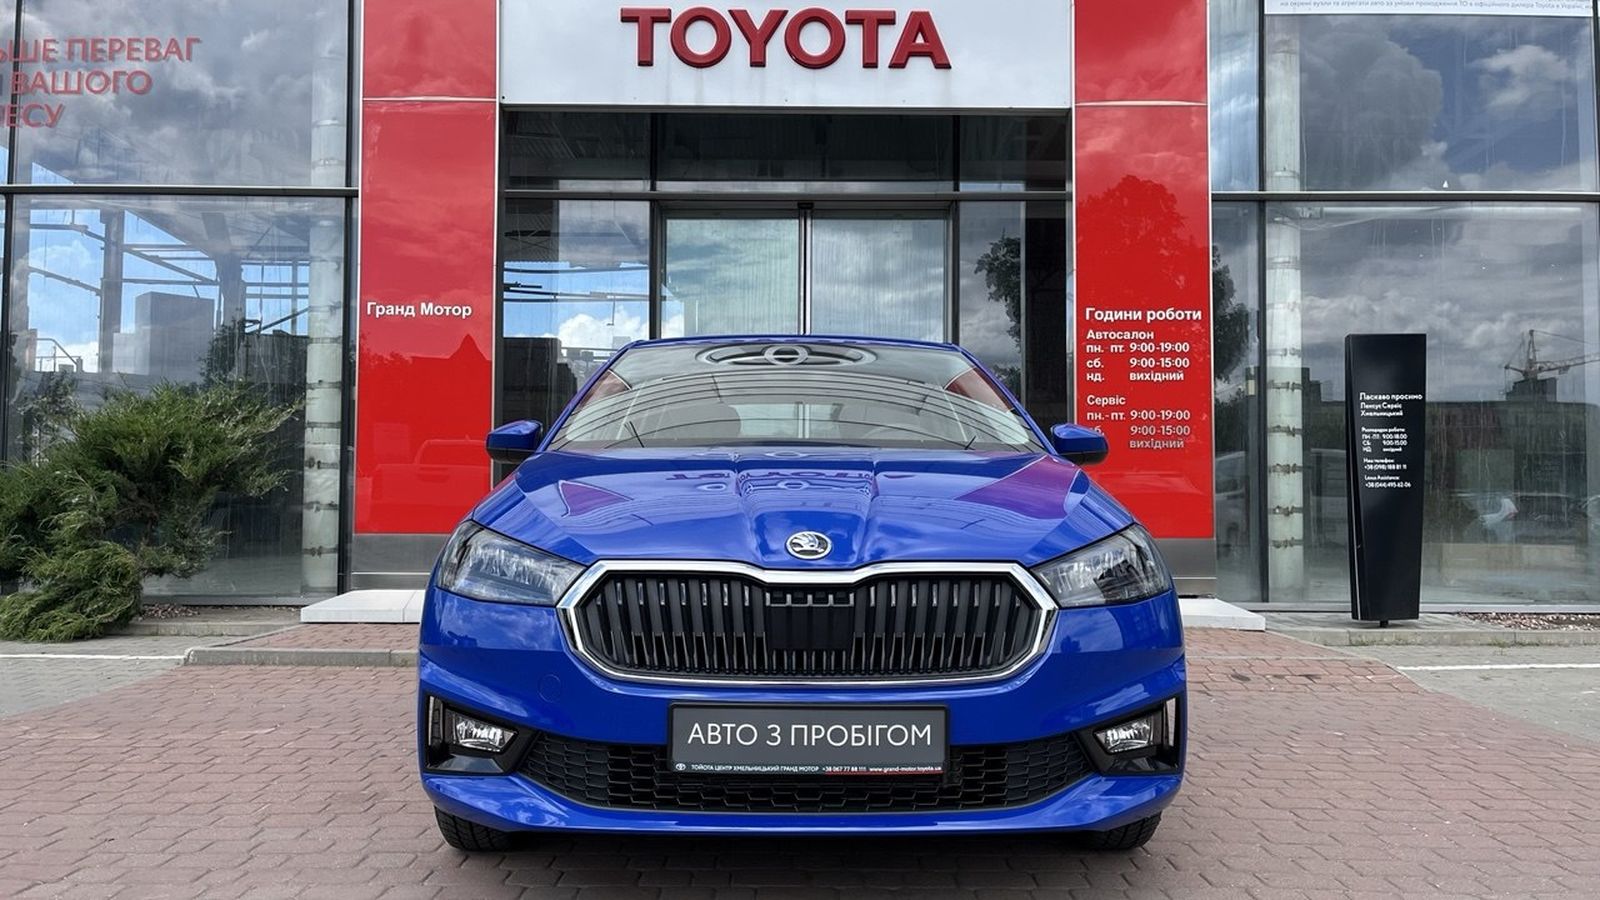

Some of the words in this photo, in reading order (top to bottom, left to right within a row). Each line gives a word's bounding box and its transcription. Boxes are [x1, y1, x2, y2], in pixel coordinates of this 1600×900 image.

[620, 6, 952, 69] TOYOTA
[67, 37, 202, 62] ПЕРЕВАГ
[12, 69, 153, 95] ВАШОГО
[0, 103, 65, 128] ЕСУ
[367, 301, 416, 318] Гранд
[420, 302, 472, 319] Мотор
[1085, 307, 1142, 322] Години
[1146, 307, 1202, 323] роботи
[1086, 330, 1154, 340] Автосалон
[1086, 357, 1104, 368] сб.
[1086, 372, 1105, 382] нд.
[1129, 370, 1184, 382] вихідний
[1086, 395, 1126, 407] Сервіс
[1129, 438, 1184, 449] вихідний
[687, 723, 758, 746] АВТО
[766, 724, 781, 746] З
[791, 724, 932, 747] ПРОБІГОМ
[780, 765, 798, 773] ГРАНД
